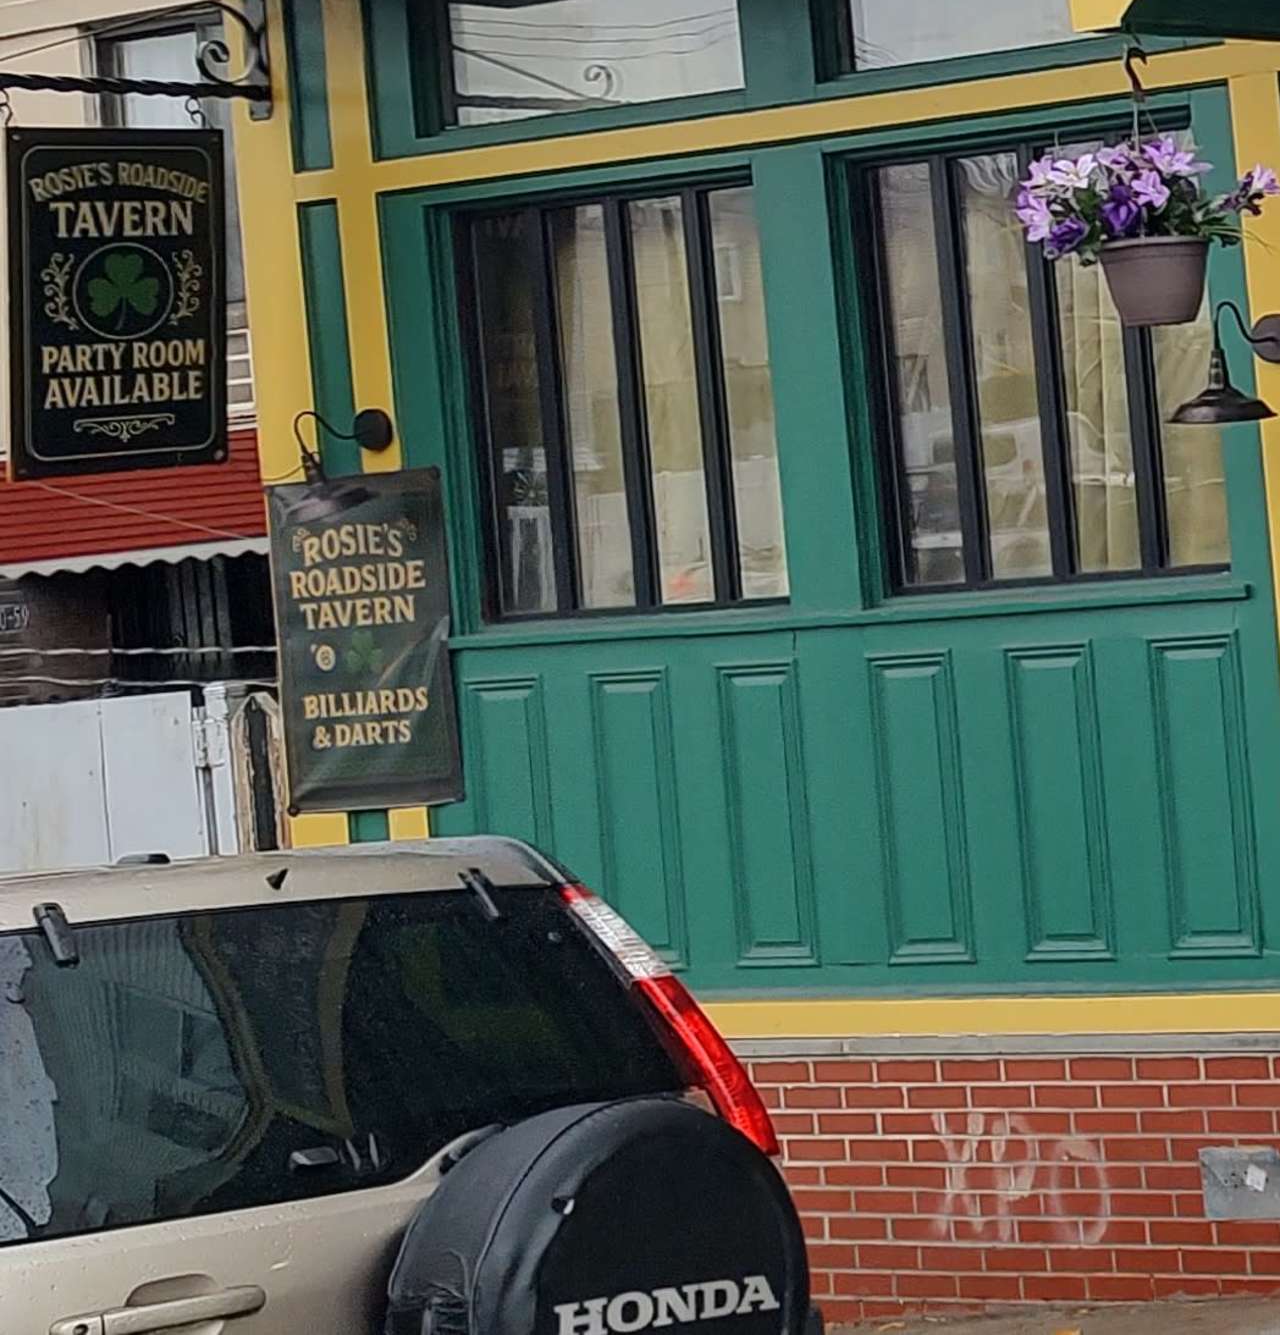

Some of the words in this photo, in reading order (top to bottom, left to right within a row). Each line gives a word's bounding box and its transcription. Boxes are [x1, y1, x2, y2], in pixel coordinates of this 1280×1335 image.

[28, 161, 114, 201] ROSIE'S
[117, 161, 209, 204] ROADSIDE
[49, 200, 194, 238] TAVERN
[41, 342, 127, 374] PARTY
[132, 338, 206, 369] ROOM
[43, 370, 204, 410] AVAILABLE
[303, 522, 404, 566] ROSIE'S
[290, 560, 426, 598] ROADSIDE
[300, 594, 416, 630] TAVERN
[303, 686, 429, 720] BILLIARDS
[313, 725, 332, 749] &
[334, 719, 412, 747] DARTS
[553, 1274, 781, 1335] HONDA
